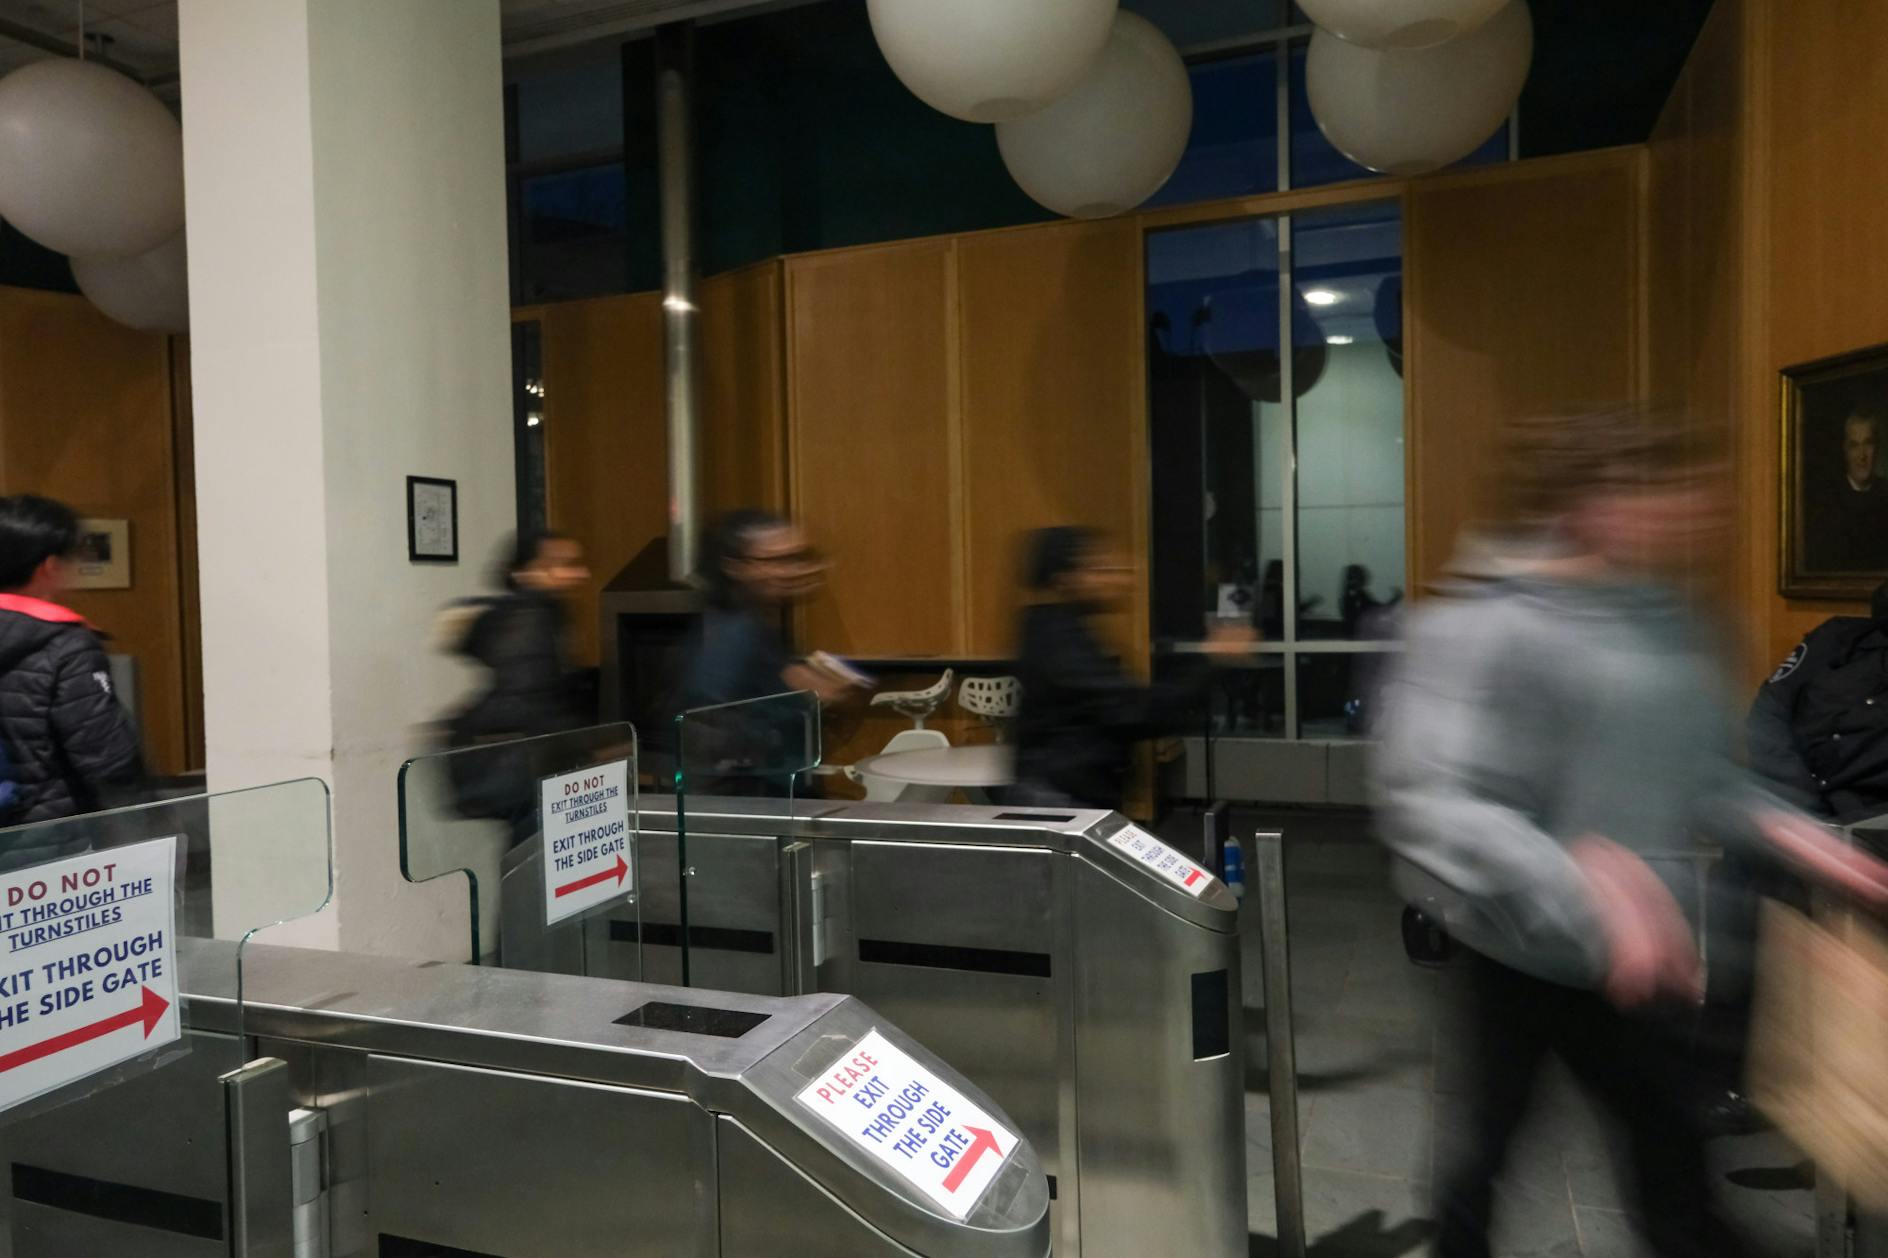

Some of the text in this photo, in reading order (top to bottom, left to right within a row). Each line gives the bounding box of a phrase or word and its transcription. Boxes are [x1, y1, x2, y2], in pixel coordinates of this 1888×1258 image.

[551, 785, 618, 813] EXIT THROUGH THE
[565, 775, 604, 796] DO NOT
[565, 801, 607, 822] TURNSTILES
[553, 820, 624, 854] EXIT THROUGH
[554, 837, 625, 872] THE SIDE GATE
[8, 863, 117, 907] DO NOT
[20, 887, 115, 924] THROUGH
[120, 877, 153, 898] THE
[8, 906, 122, 951] TURNSTILES
[0, 930, 163, 998] XIT THROUGH
[0, 957, 163, 1031] HE SIDE GATE
[816, 1050, 879, 1105] PLEASE
[853, 1075, 890, 1109] EXIT
[862, 1080, 930, 1144] THROUGH
[893, 1100, 952, 1159] THE SIDE
[930, 1128, 969, 1169] GATE
